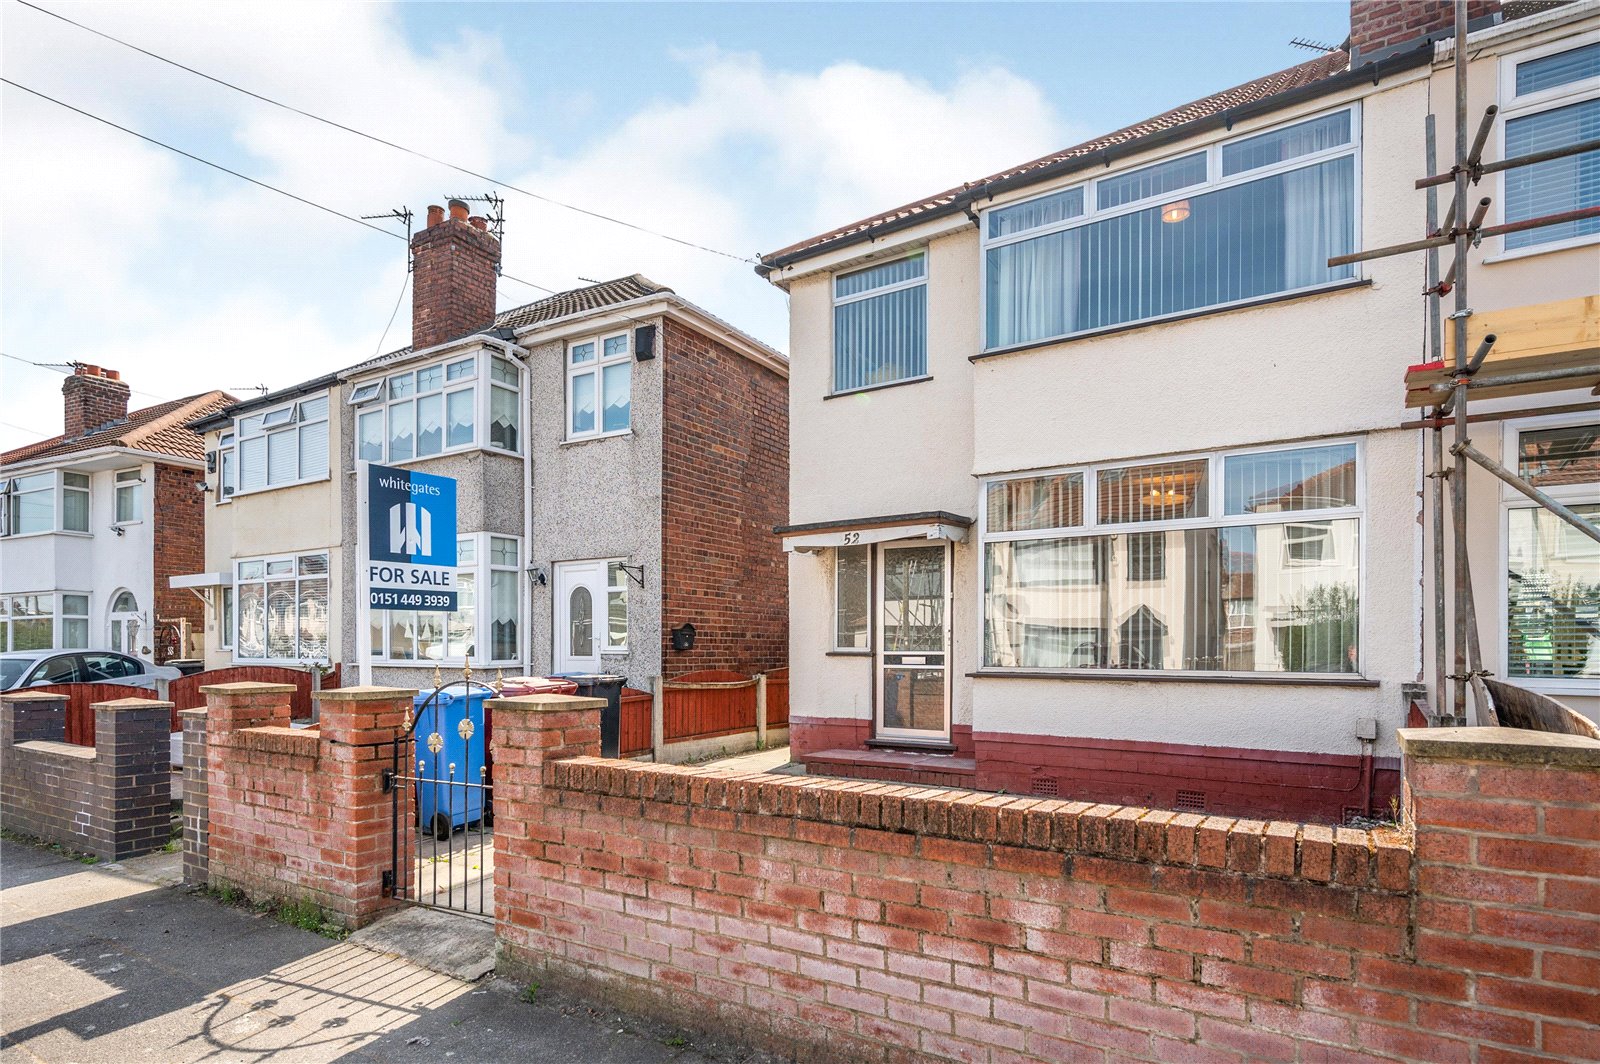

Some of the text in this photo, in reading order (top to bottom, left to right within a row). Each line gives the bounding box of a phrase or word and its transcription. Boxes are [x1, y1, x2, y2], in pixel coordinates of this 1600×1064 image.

[379, 477, 441, 496] whitegates
[844, 532, 860, 545] 52
[370, 566, 450, 586] FOR SALE
[370, 592, 450, 607] 0151 449 3939
